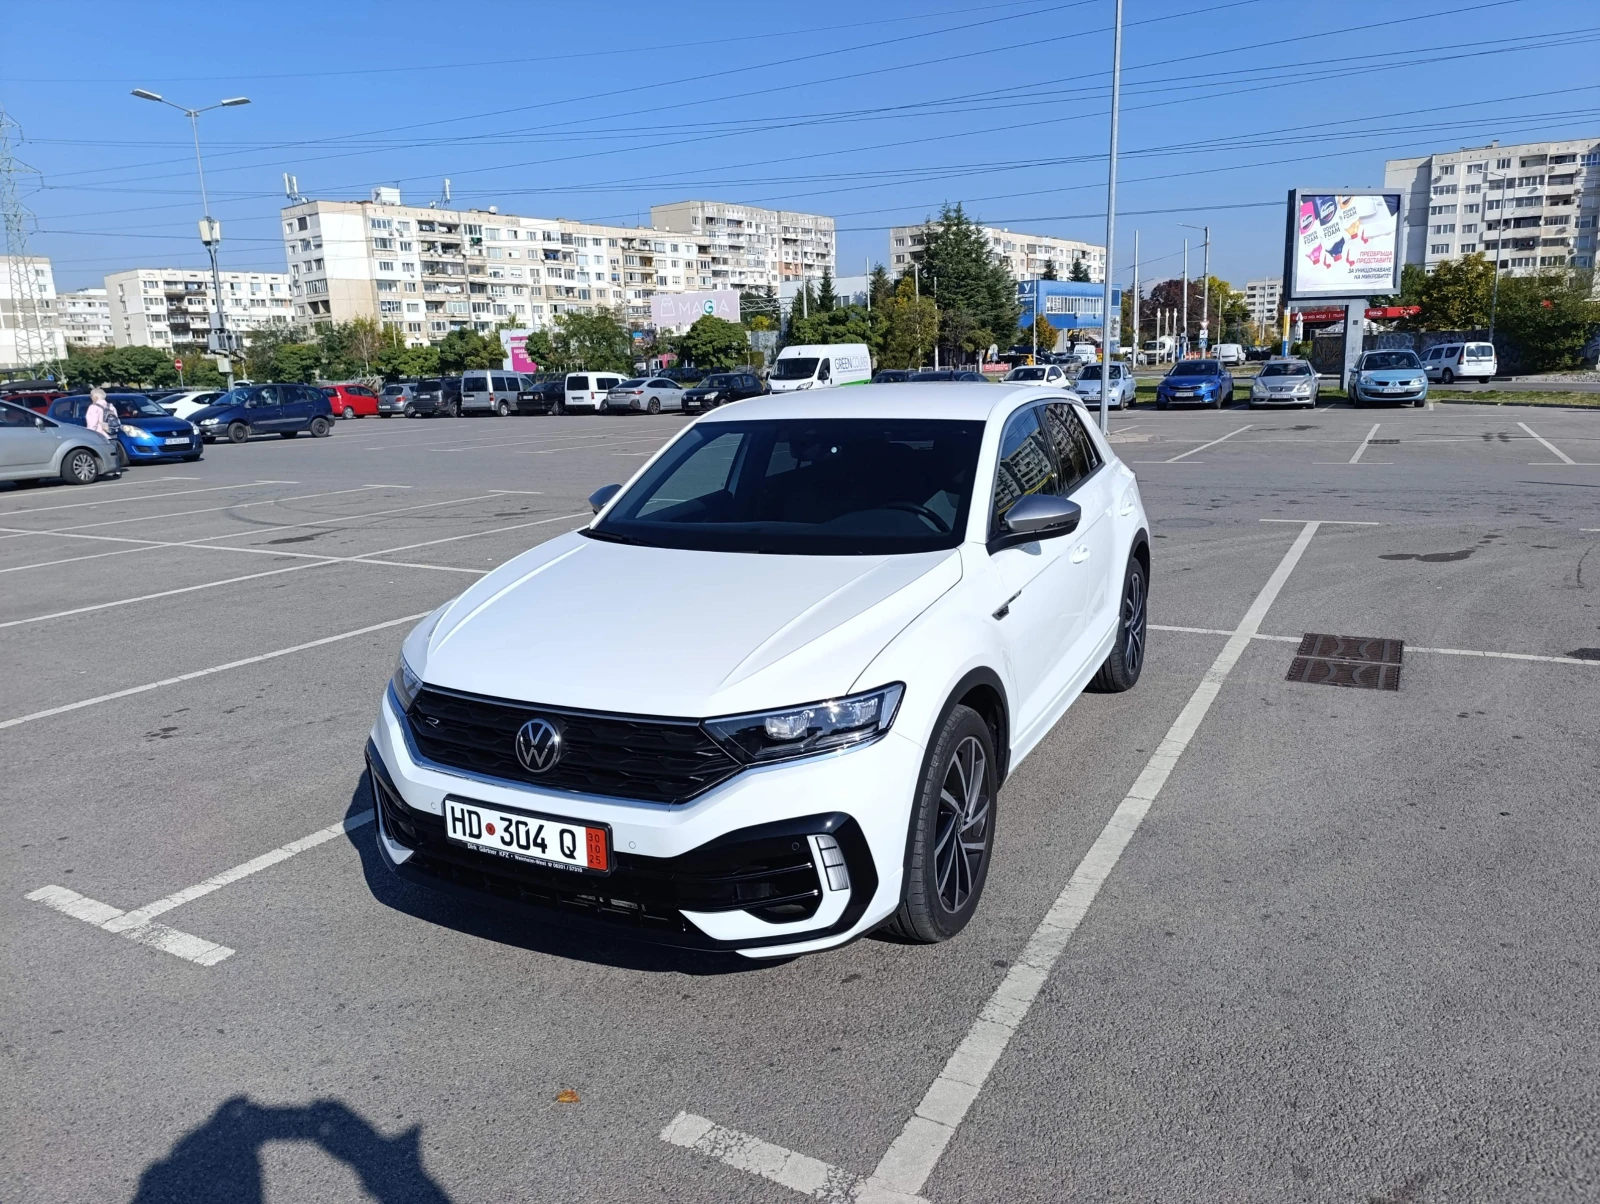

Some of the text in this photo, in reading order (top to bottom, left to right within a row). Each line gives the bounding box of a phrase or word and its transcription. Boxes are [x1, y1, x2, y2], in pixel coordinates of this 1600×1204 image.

[1323, 222, 1340, 232] POWER
[1324, 227, 1341, 239] FOAM
[678, 299, 730, 316] MAGIA
[450, 805, 577, 861] HD 304 Q
[588, 832, 600, 842] 30
[467, 842, 478, 851] Dirk
[478, 846, 497, 856] Gärtner
[499, 850, 510, 859] KFZ
[589, 843, 601, 854] 10
[589, 854, 602, 865] 25
